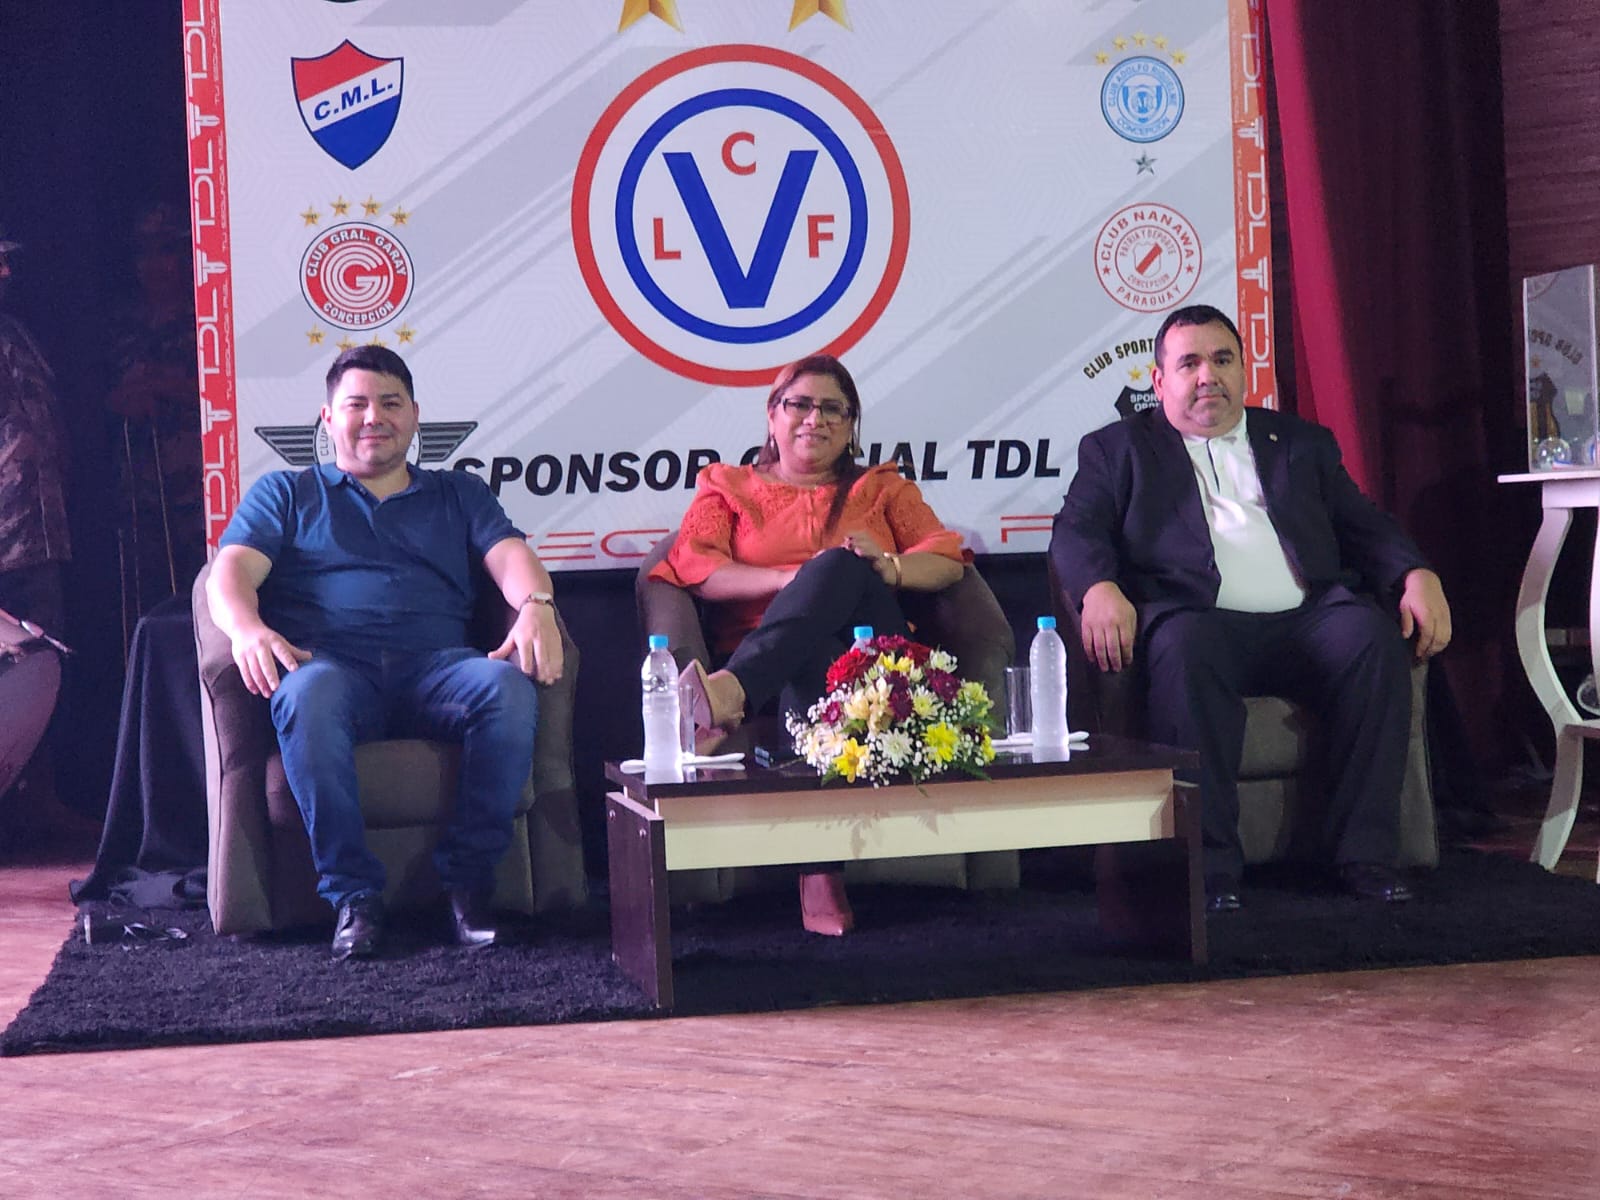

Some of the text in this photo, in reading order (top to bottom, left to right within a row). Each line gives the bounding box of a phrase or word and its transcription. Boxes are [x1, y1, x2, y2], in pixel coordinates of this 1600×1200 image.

[314, 78, 393, 120] C.M.L.
[721, 131, 757, 176] C
[193, 139, 215, 244] TDL
[1247, 154, 1267, 254] TDL
[307, 229, 407, 277] CLUB GRAL. GARAY
[653, 150, 835, 309] L V F
[1101, 210, 1194, 261] CLUB NANAWA
[323, 300, 395, 325] CONCEPCION
[198, 287, 220, 392] TDL
[1251, 295, 1270, 394] TDL
[1083, 352, 1113, 379] CLUB
[966, 438, 1060, 480] TDL
[205, 434, 226, 539] TDL
